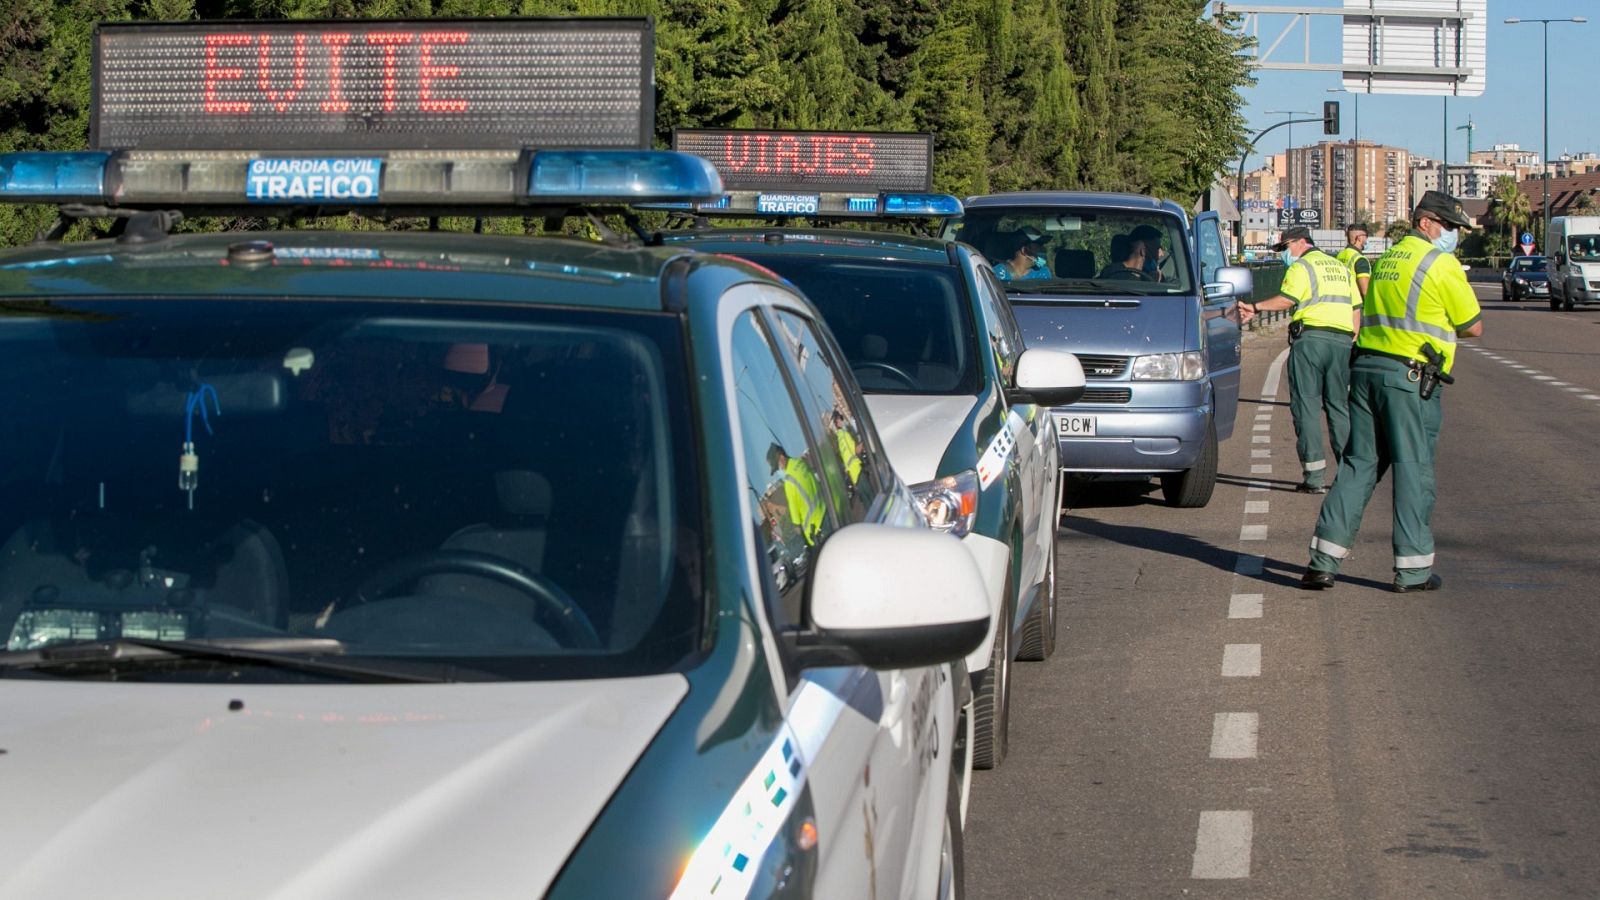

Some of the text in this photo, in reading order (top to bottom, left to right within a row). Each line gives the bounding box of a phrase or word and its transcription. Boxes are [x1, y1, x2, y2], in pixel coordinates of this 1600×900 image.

[205, 33, 469, 112] EVITE
[724, 135, 875, 176] VIAJES
[252, 159, 376, 174] GUARDIA CIVIL
[251, 175, 374, 199] TRAFICO
[760, 194, 796, 202] GUARDIA
[760, 201, 816, 213] TRAFICO
[1380, 260, 1398, 269] CIVIL
